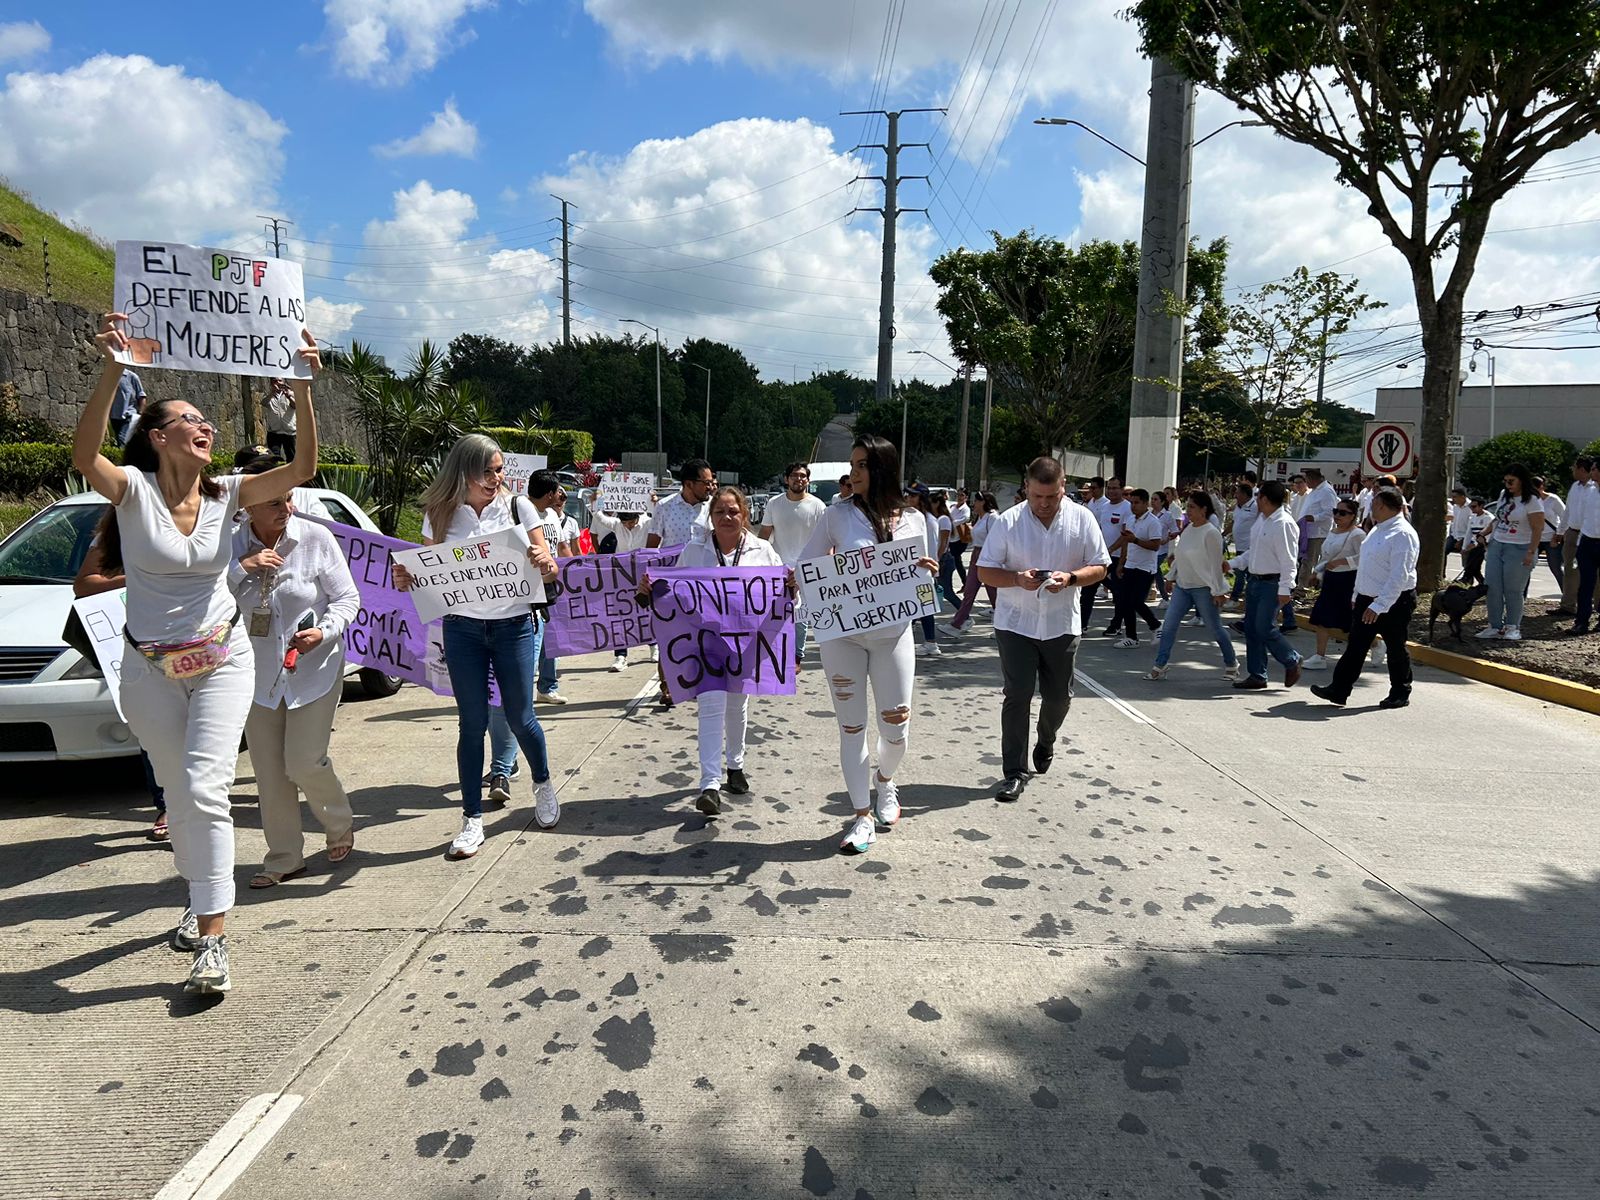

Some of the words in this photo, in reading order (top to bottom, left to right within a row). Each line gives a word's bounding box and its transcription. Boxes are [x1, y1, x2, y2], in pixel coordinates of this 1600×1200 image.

[143, 246, 192, 276] EL
[211, 253, 268, 287] PJF
[132, 282, 251, 315] DEFIENDE
[259, 295, 272, 318] A
[278, 297, 305, 323] LAS
[166, 320, 292, 370] MUJERES
[505, 476, 527, 493] JF
[602, 484, 620, 494] PARA
[617, 494, 631, 502] LAS
[603, 501, 648, 512] INFANCIAS
[417, 550, 448, 567] EL
[452, 541, 491, 562] PJF
[801, 562, 828, 584] EL
[833, 545, 876, 576] PJF
[881, 545, 920, 566] SIRVE
[411, 573, 428, 591] NO
[430, 573, 449, 586] ES
[450, 561, 518, 583] ENEMIGO
[819, 583, 852, 601] PARA
[855, 564, 921, 593] PROTEGER
[442, 589, 475, 607] DEL
[476, 579, 531, 601] PUEBLO
[568, 595, 598, 620] EL
[650, 576, 766, 622] CONFIO
[853, 593, 876, 605] TU
[353, 607, 412, 640] OMÍA
[771, 599, 795, 623] LA
[835, 599, 919, 632] LIBERTAD
[342, 626, 413, 671] ICIAL
[667, 628, 788, 690] SCJN
